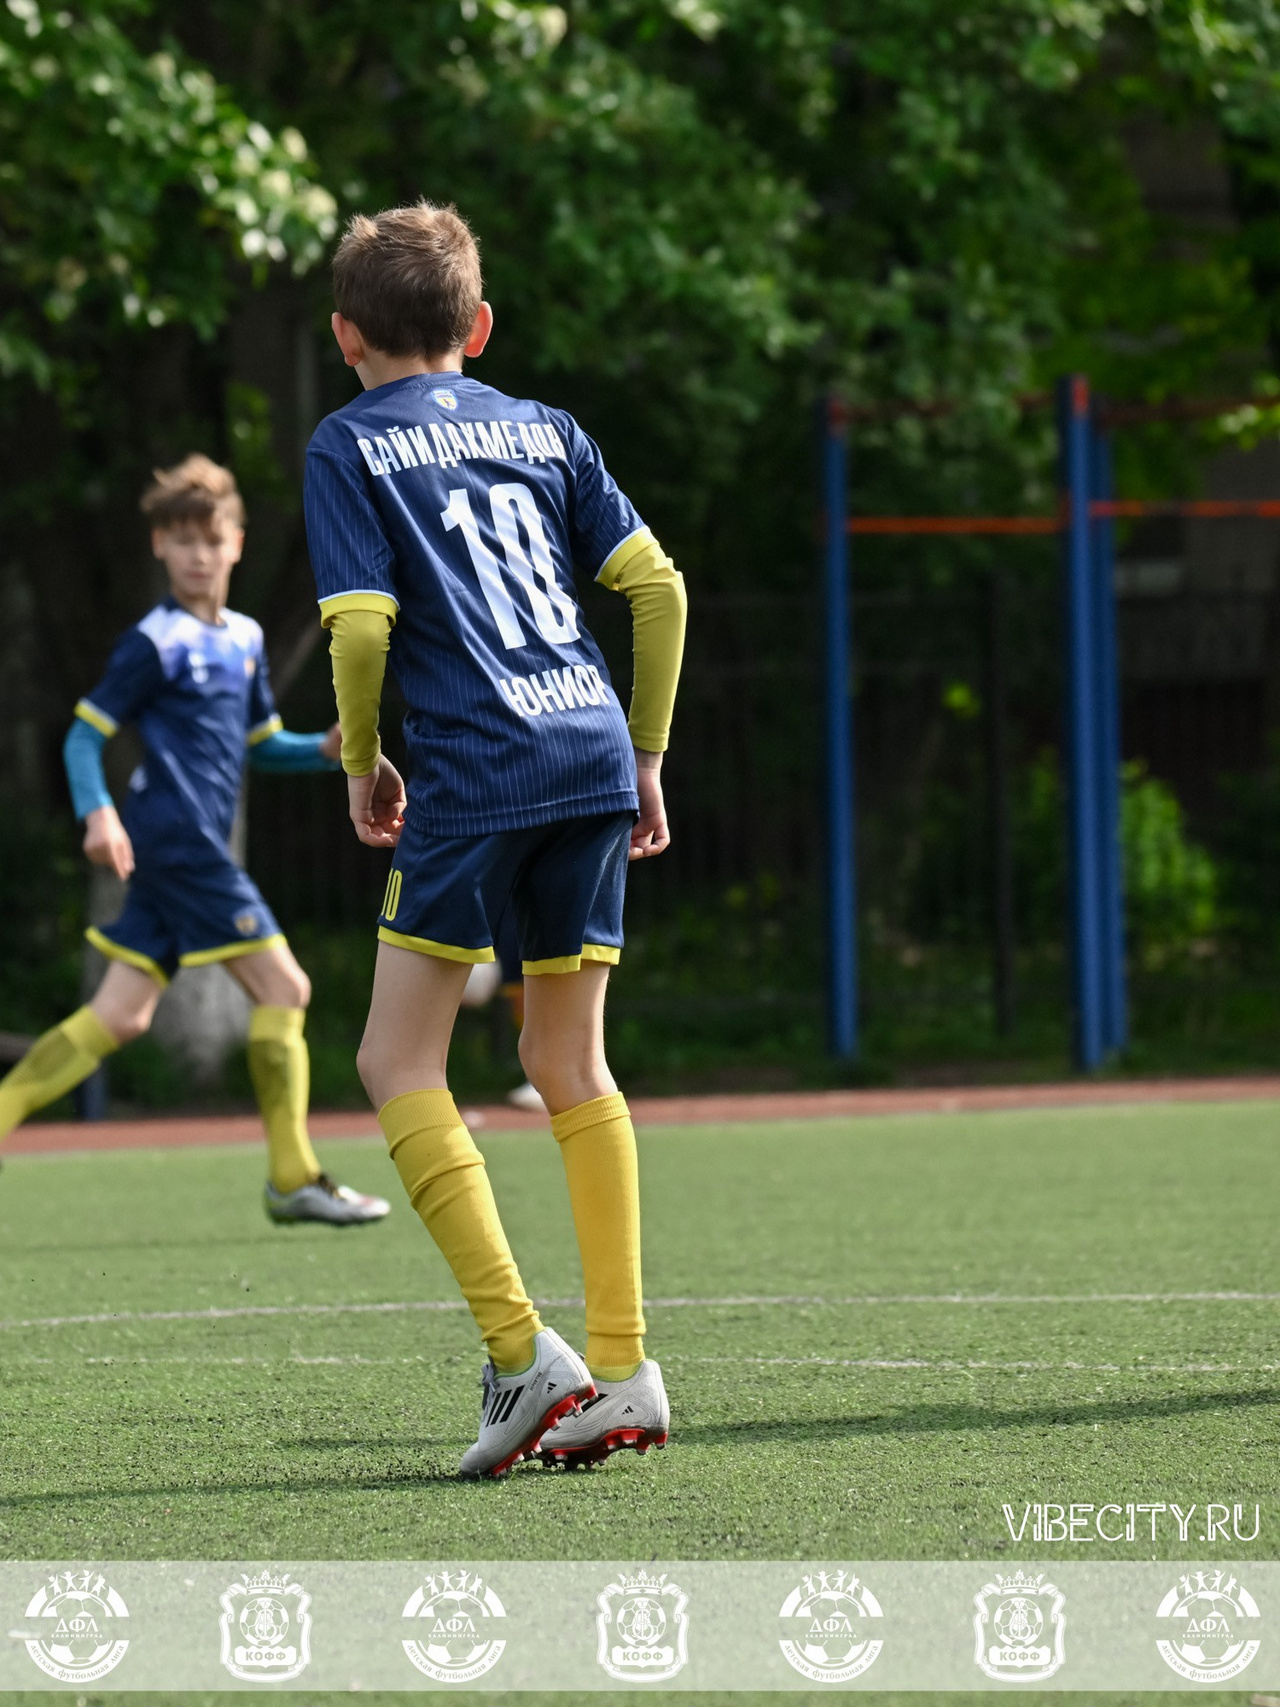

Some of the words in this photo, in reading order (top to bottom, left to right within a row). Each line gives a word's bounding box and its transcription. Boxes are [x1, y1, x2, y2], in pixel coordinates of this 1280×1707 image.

[357, 421, 566, 476] САЙИДАХМЕДОВ
[440, 483, 581, 650] 10
[499, 665, 609, 716] ЮНИОР
